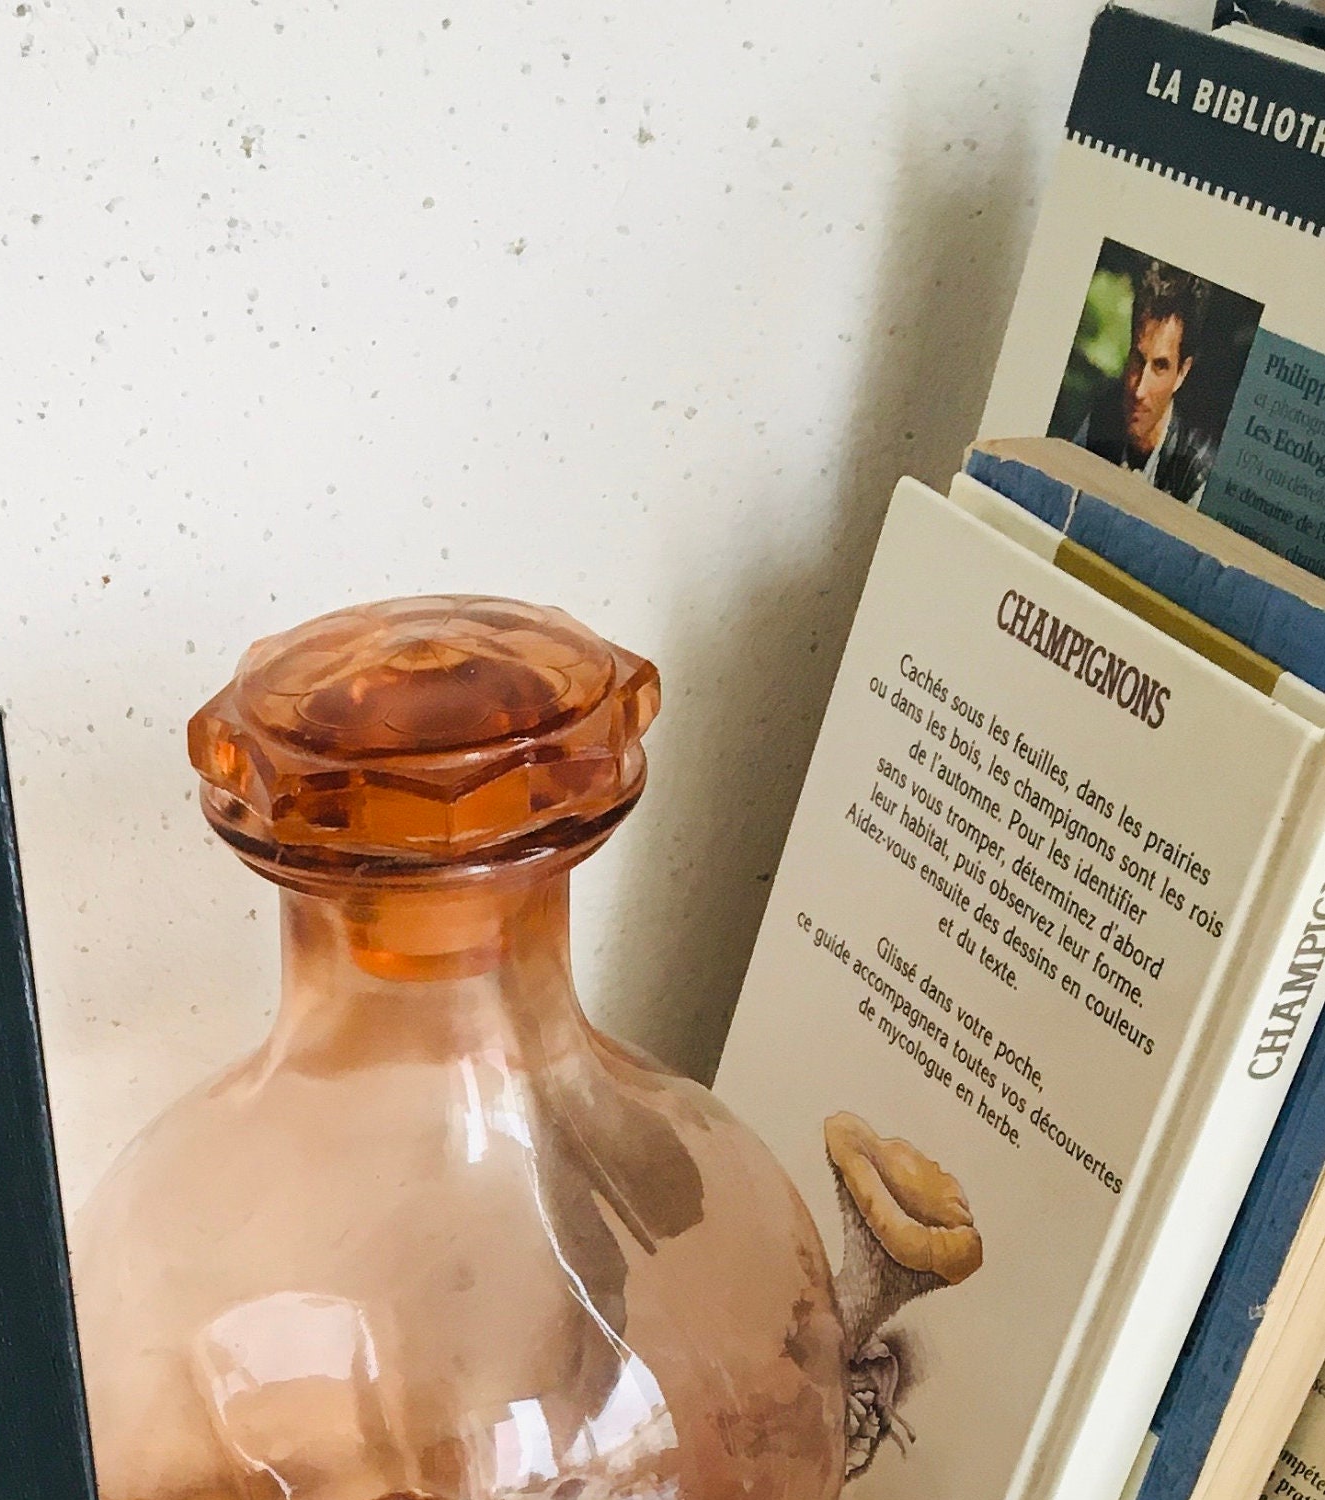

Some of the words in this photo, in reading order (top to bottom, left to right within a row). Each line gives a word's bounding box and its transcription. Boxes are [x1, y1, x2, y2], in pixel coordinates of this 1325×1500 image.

[1146, 62, 1182, 105] LA
[1244, 414, 1272, 445] Les
[996, 588, 1172, 730] CHAMPIGNONS
[869, 676, 889, 700] ou
[890, 687, 924, 724] dans
[925, 709, 948, 742] les
[948, 726, 982, 772] bois,
[987, 753, 1011, 787] les
[1013, 777, 1117, 863] champignons
[1118, 854, 1157, 892] sont
[1159, 876, 1186, 912] les
[1188, 903, 1224, 938] rois
[900, 653, 949, 703] Cachés
[950, 695, 986, 729] sous
[987, 714, 1011, 747] les
[1012, 731, 1070, 794] feuilles,
[1076, 778, 1115, 820] dans
[1117, 803, 1143, 839] les
[1142, 830, 1211, 887] prairies
[908, 739, 927, 766] de
[929, 751, 1002, 823] l'automne.
[1007, 808, 1046, 851] Pour
[1046, 837, 1071, 871] les
[1073, 857, 1148, 926] identifier
[844, 802, 918, 871] Aidez-vous
[919, 864, 971, 913] ensuite
[973, 902, 1000, 935] des
[1002, 925, 1059, 980] dessins
[1061, 974, 1081, 1000] en
[1084, 993, 1155, 1056] couleurs
[869, 781, 899, 817] leur
[898, 803, 950, 862] habitat,
[952, 852, 987, 886] puis
[988, 878, 1056, 939] observez
[1056, 923, 1091, 964] leur
[1091, 951, 1143, 1009] forme.
[876, 757, 908, 790] sans
[911, 780, 944, 816] vous
[945, 805, 1006, 868] tromper,
[1011, 855, 1097, 931] déterminez
[1099, 920, 1165, 981] d'abord
[938, 916, 955, 939] et
[956, 927, 977, 957] du
[979, 945, 1018, 991] texte.
[796, 911, 813, 933] ce
[812, 927, 851, 966] guide
[852, 958, 949, 1050] accompagnera
[952, 1039, 998, 1089] toutes
[1001, 1082, 1027, 1114] vos
[1029, 1106, 1124, 1195] découvertes
[858, 996, 876, 1022] de
[877, 1016, 953, 1089] mycologue
[955, 1082, 974, 1107] en
[976, 1094, 1021, 1149] herbe.
[876, 936, 918, 984] Glissé
[919, 974, 954, 1014] dans
[957, 1006, 993, 1048] votre
[993, 1040, 1044, 1094] poche,
